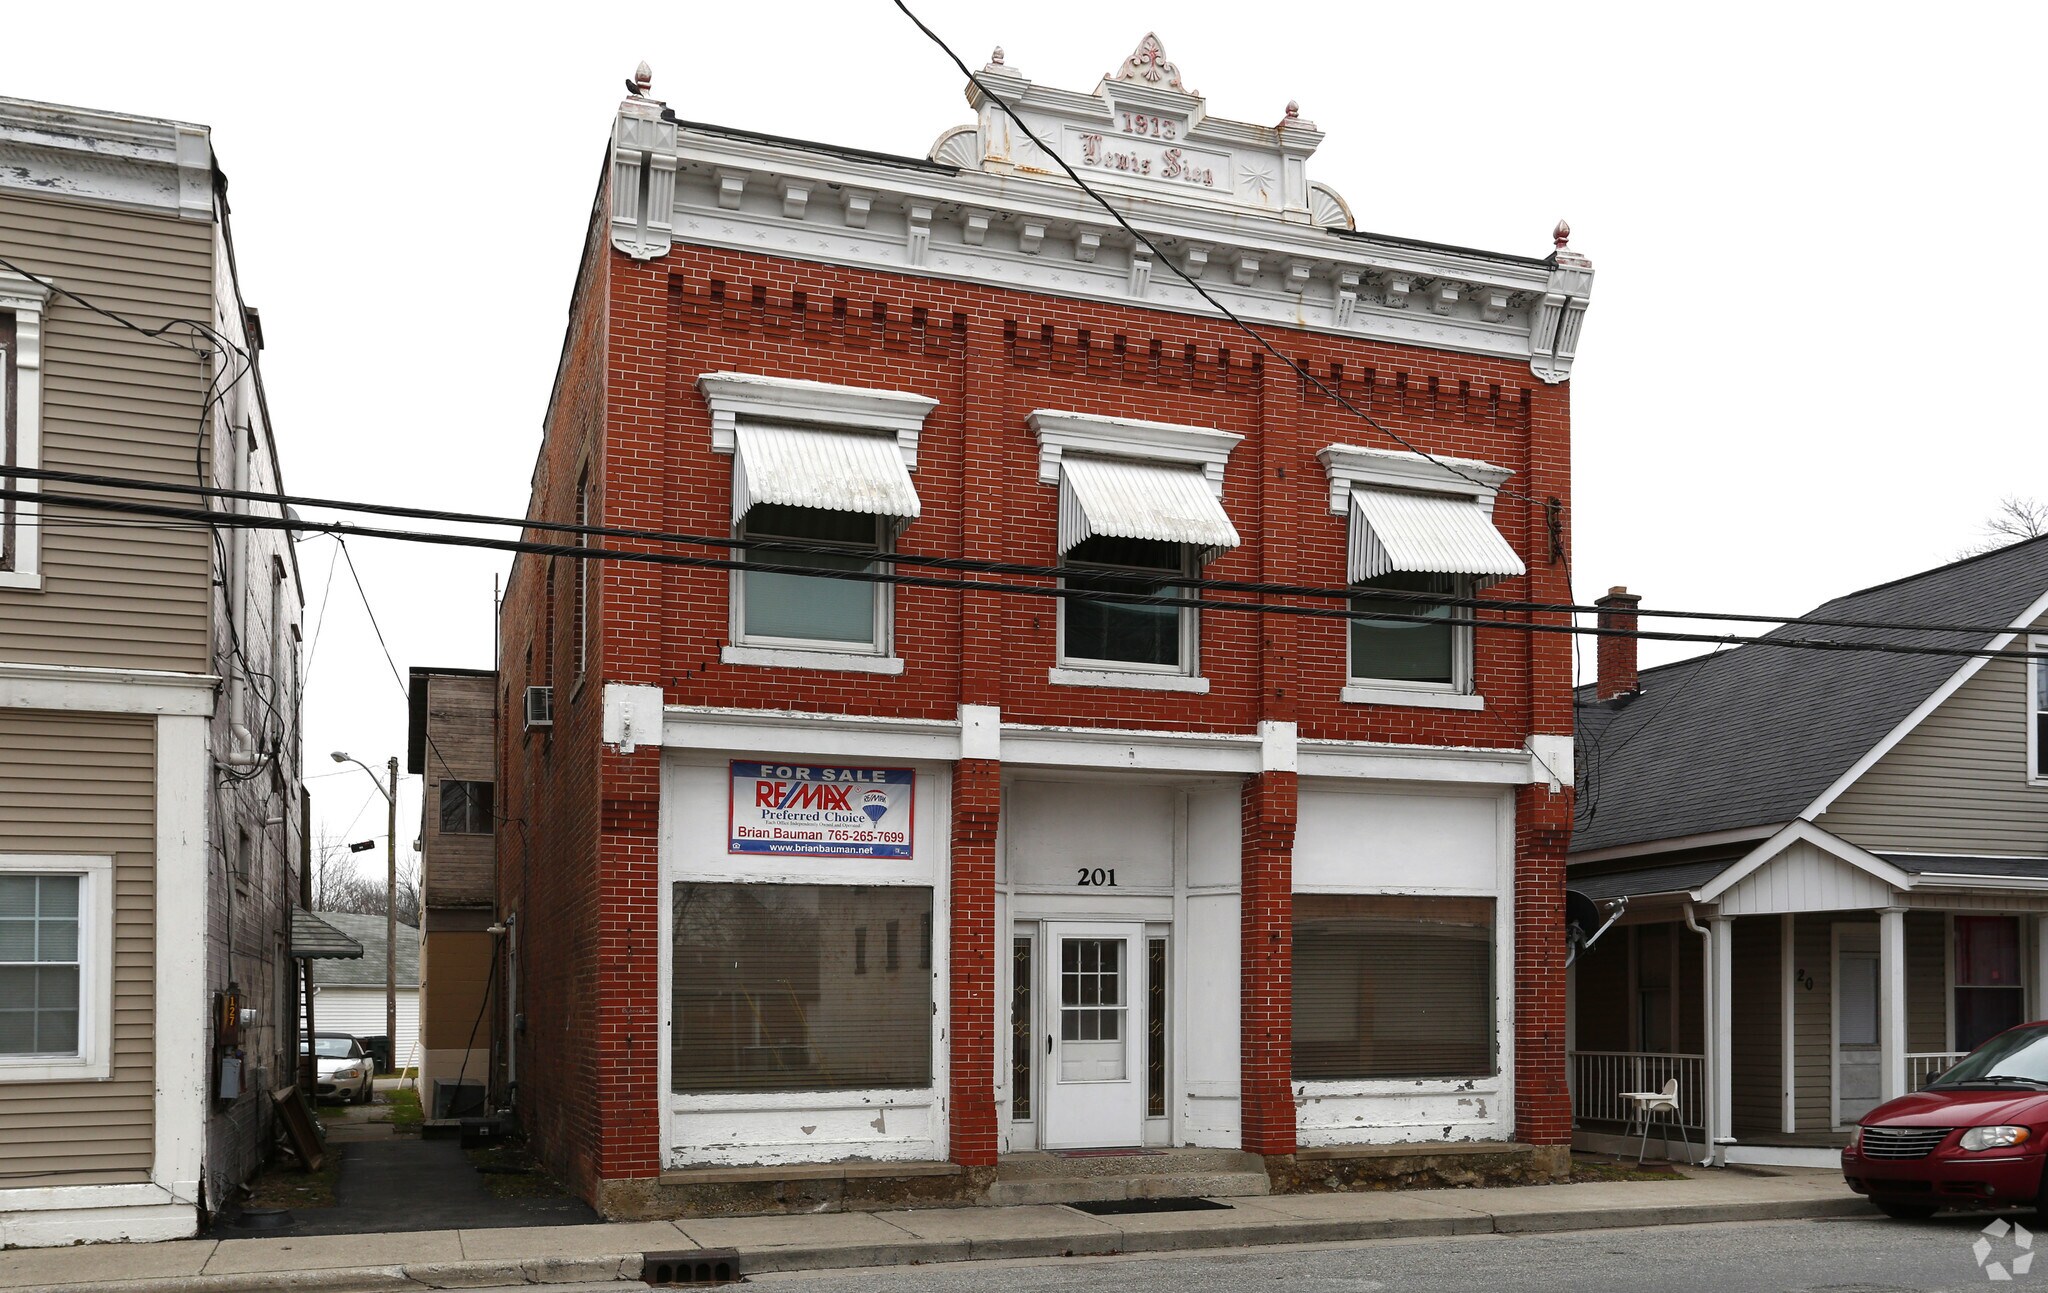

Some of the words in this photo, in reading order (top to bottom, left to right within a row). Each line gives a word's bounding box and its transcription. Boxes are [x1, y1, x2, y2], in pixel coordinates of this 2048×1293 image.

[1122, 111, 1176, 139] 1913
[760, 764, 810, 780] FOR
[822, 768, 886, 783] SALE
[755, 780, 854, 811] RE/MAX
[761, 809, 820, 822] Preferred
[824, 811, 865, 823] Choice
[738, 826, 770, 838] Brian
[773, 827, 823, 840] Bauman
[828, 829, 904, 842] 765-265-7699
[769, 843, 873, 855] www.brianbauman.net
[1077, 867, 1118, 887] 201
[1797, 968, 1814, 991] 20
